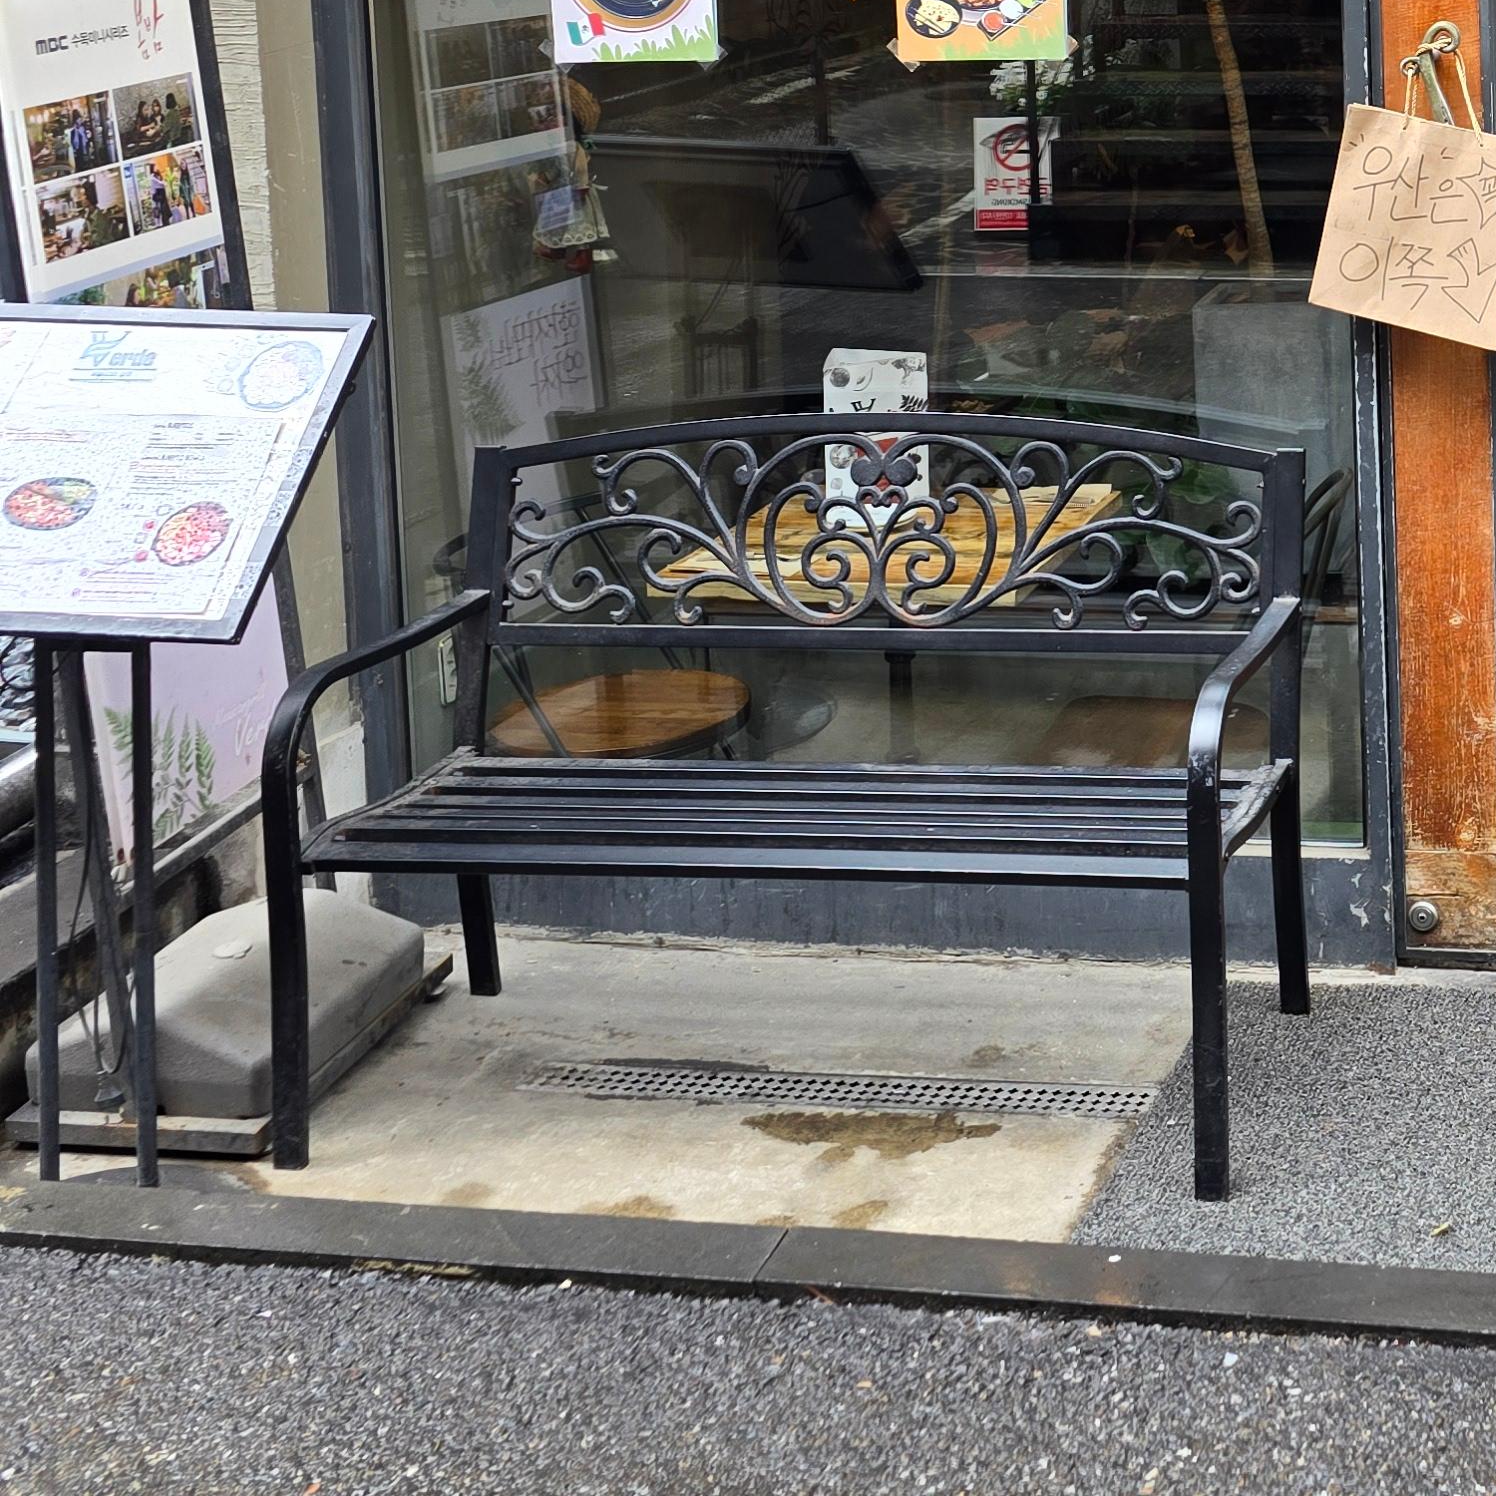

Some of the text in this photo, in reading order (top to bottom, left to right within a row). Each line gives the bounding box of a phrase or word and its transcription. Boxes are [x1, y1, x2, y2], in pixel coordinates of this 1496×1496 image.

[35, 35, 69, 55] MBC
[1353, 146, 1468, 224] 우산은
[1340, 236, 1449, 311] 이쪽
